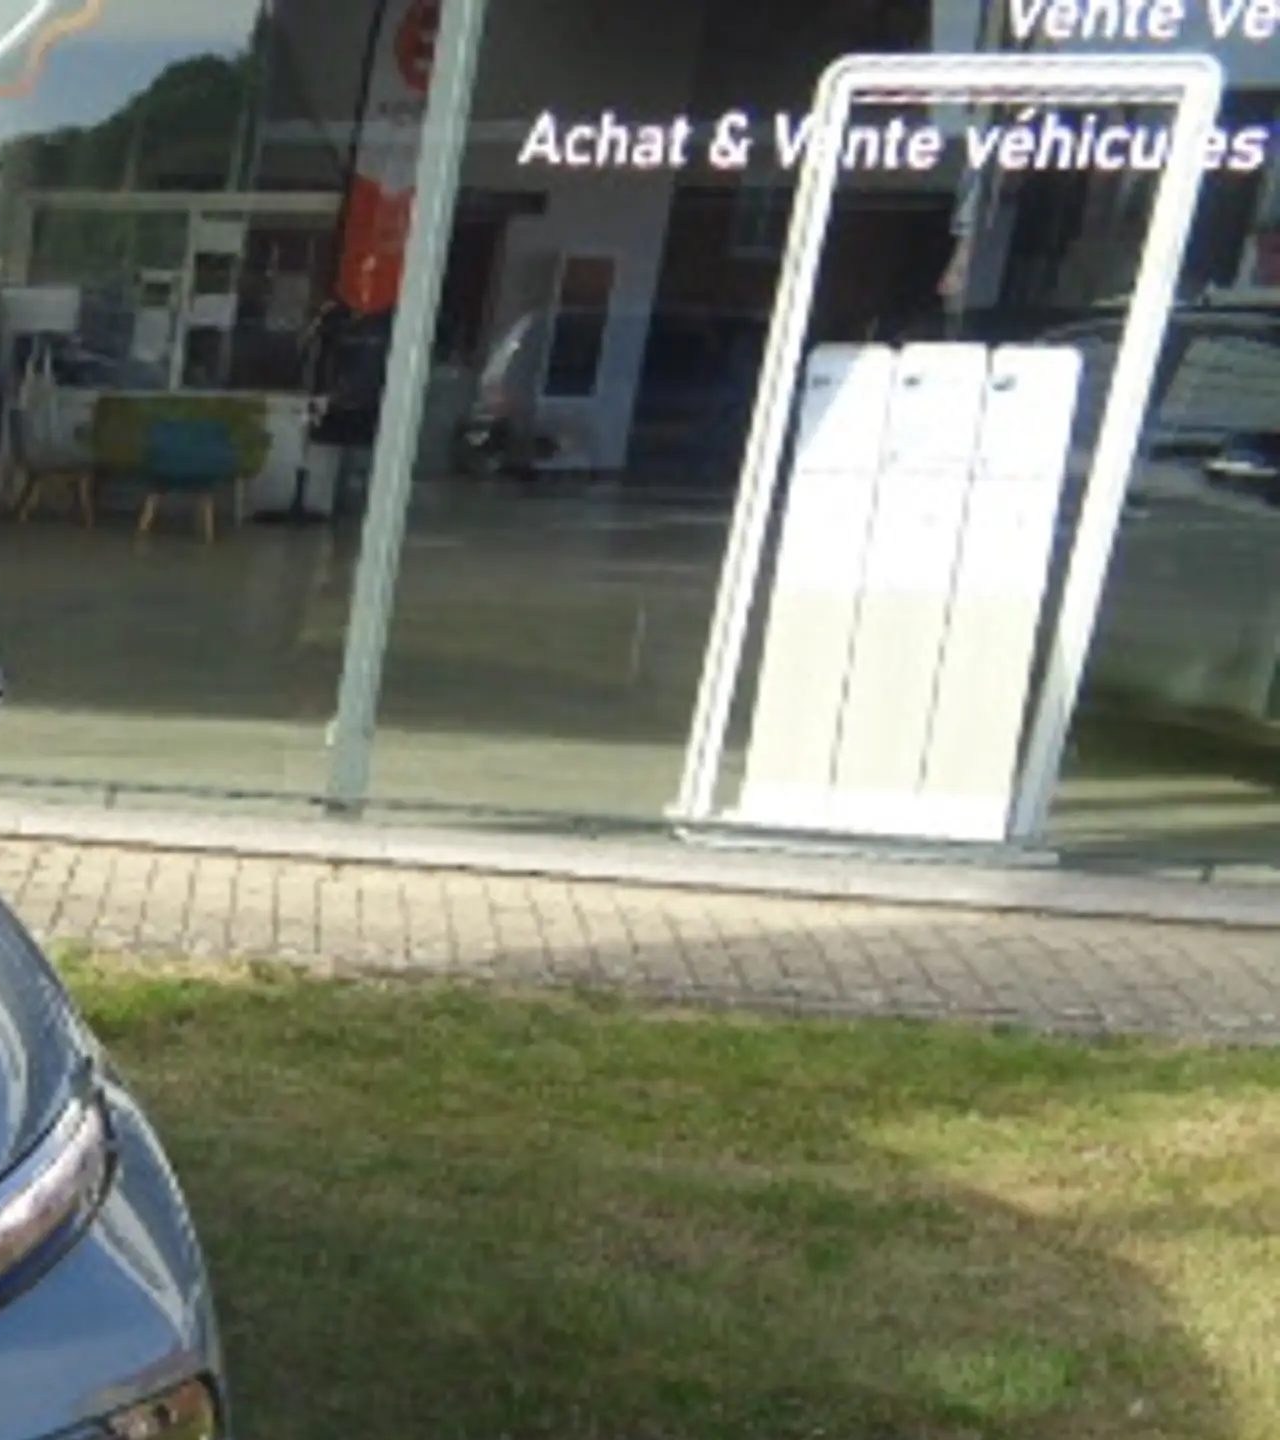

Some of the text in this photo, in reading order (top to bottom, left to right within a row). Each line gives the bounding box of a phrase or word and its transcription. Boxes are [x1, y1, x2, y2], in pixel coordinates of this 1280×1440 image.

[516, 107, 1270, 171] Achat & Vnte véhicues
